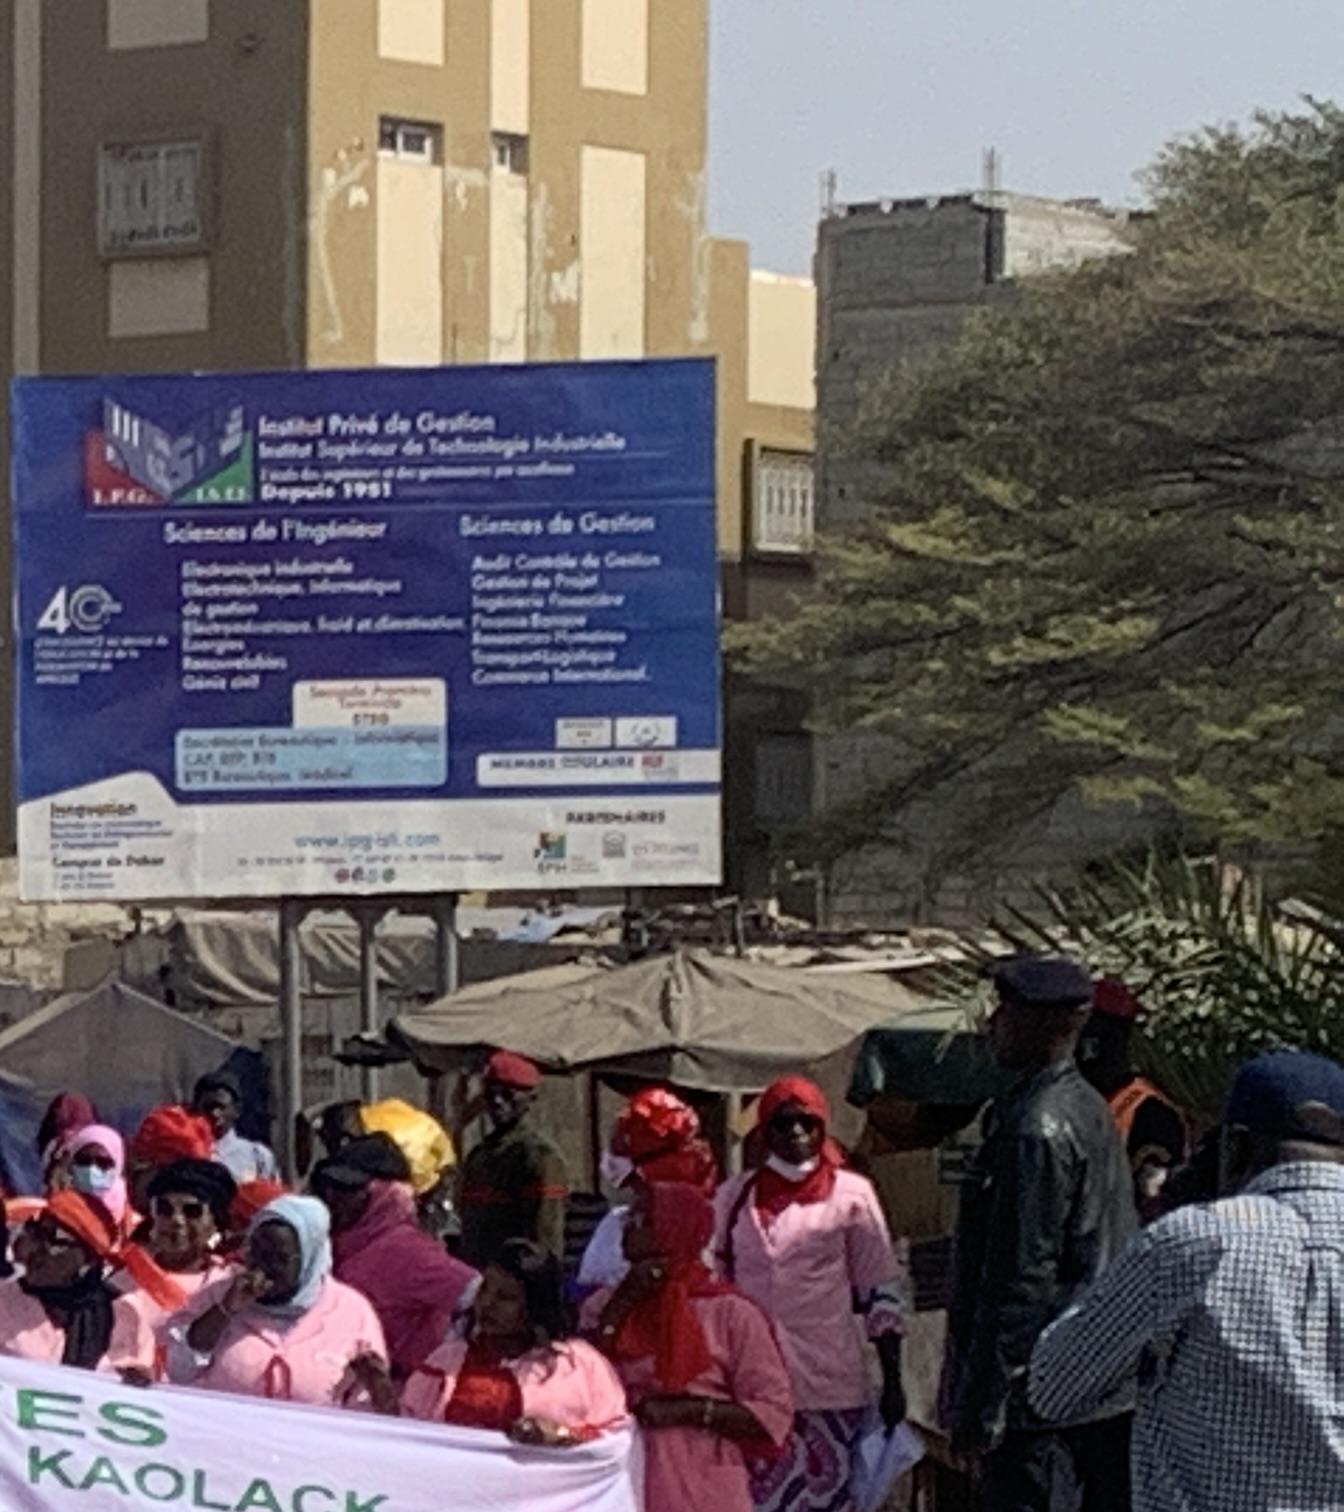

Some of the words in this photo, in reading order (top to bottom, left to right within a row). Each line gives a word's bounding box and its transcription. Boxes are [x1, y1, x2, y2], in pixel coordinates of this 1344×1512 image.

[259, 415, 324, 436] Institut
[328, 411, 378, 435] Privé
[384, 412, 412, 434] de
[416, 409, 496, 433] Gestion
[401, 438, 424, 456] de
[428, 435, 530, 459] Technologie
[261, 482, 337, 504] Depuis
[164, 520, 247, 544] Sciences
[250, 519, 278, 541] de
[459, 513, 544, 538] Sciences
[547, 512, 574, 535] de
[579, 511, 656, 534] Gestion
